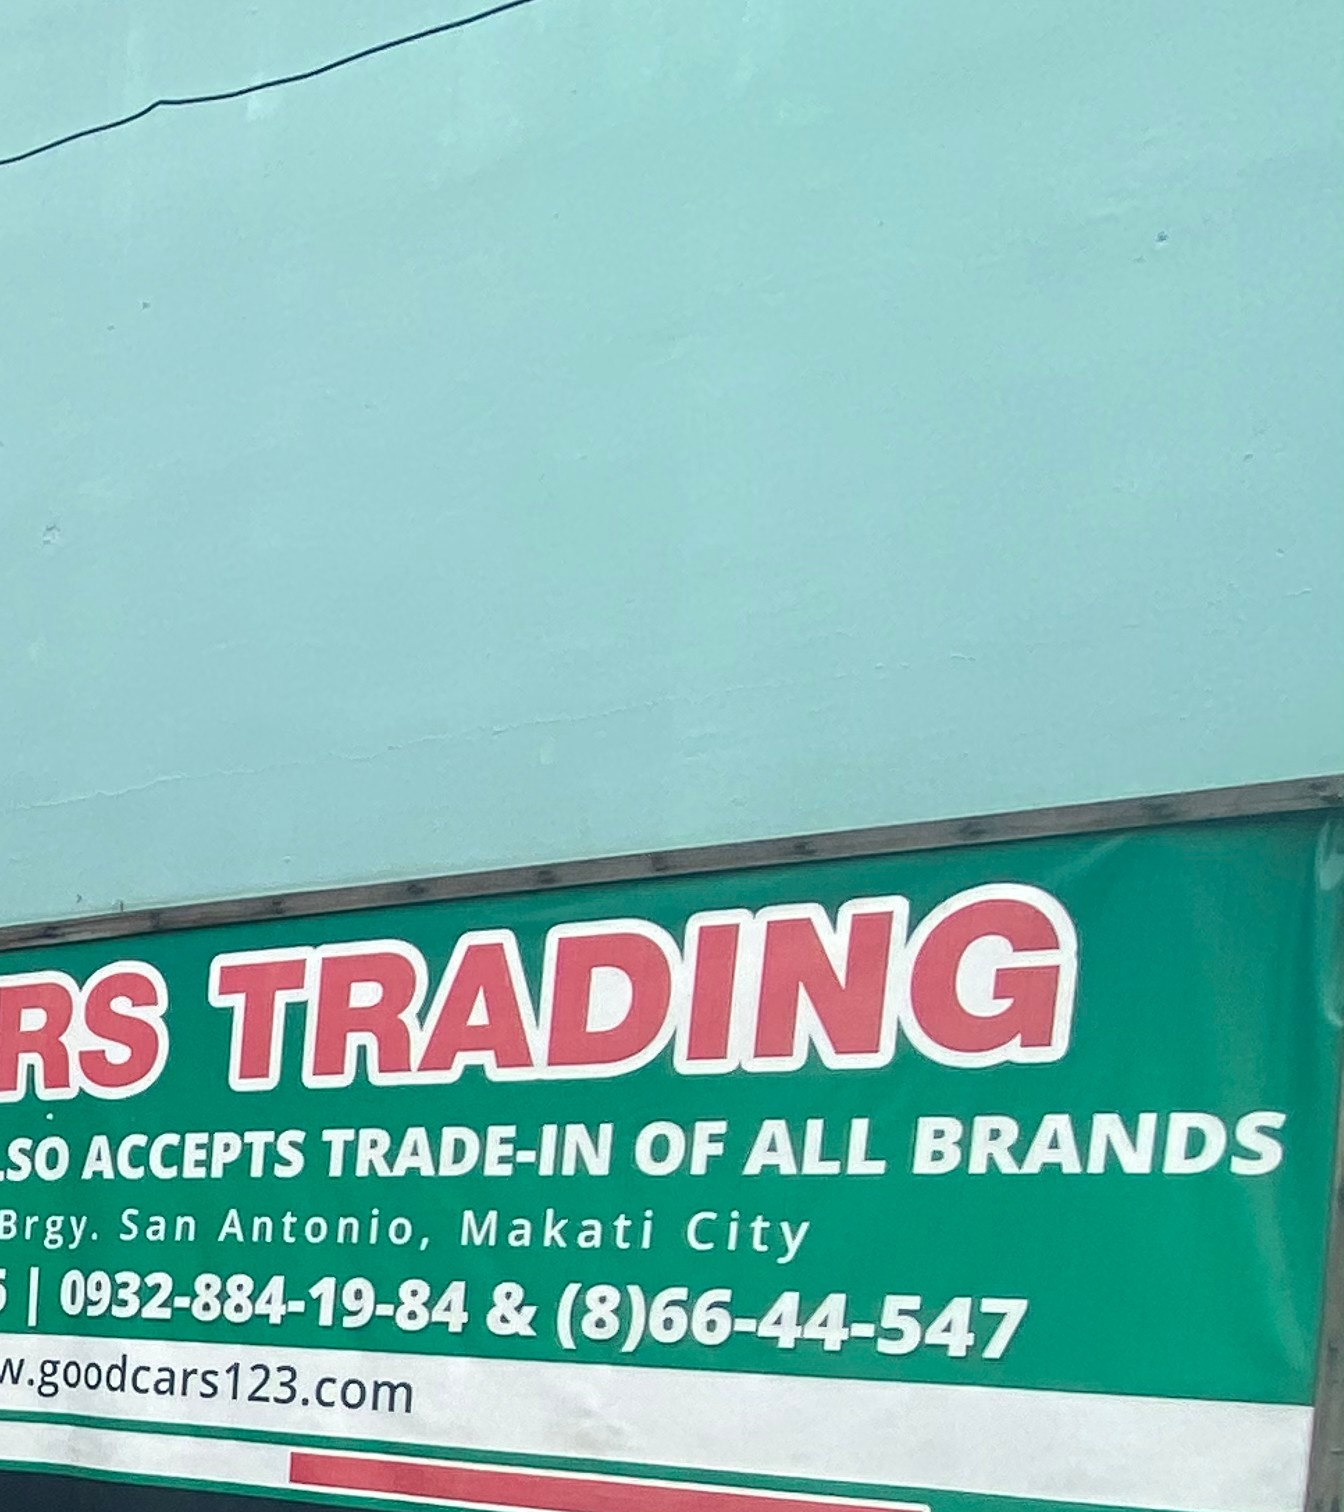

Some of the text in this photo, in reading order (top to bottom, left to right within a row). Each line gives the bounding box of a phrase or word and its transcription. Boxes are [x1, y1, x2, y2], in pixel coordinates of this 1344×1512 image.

[210, 883, 1079, 1092] TRADING
[81, 1129, 306, 1180] ACCEPTS
[322, 1122, 613, 1177] TRADE-IN
[635, 1120, 728, 1176] OF
[742, 1117, 887, 1175] ALL
[912, 1111, 1287, 1176] BRANDS
[119, 1208, 195, 1242] San
[217, 1208, 429, 1251] Antonio,
[461, 1208, 653, 1249] Makati
[687, 1210, 810, 1264] City
[60, 1269, 469, 1333] 0932-884-19-84
[486, 1282, 537, 1336] &
[555, 1282, 1029, 1361] (8)66-44-547
